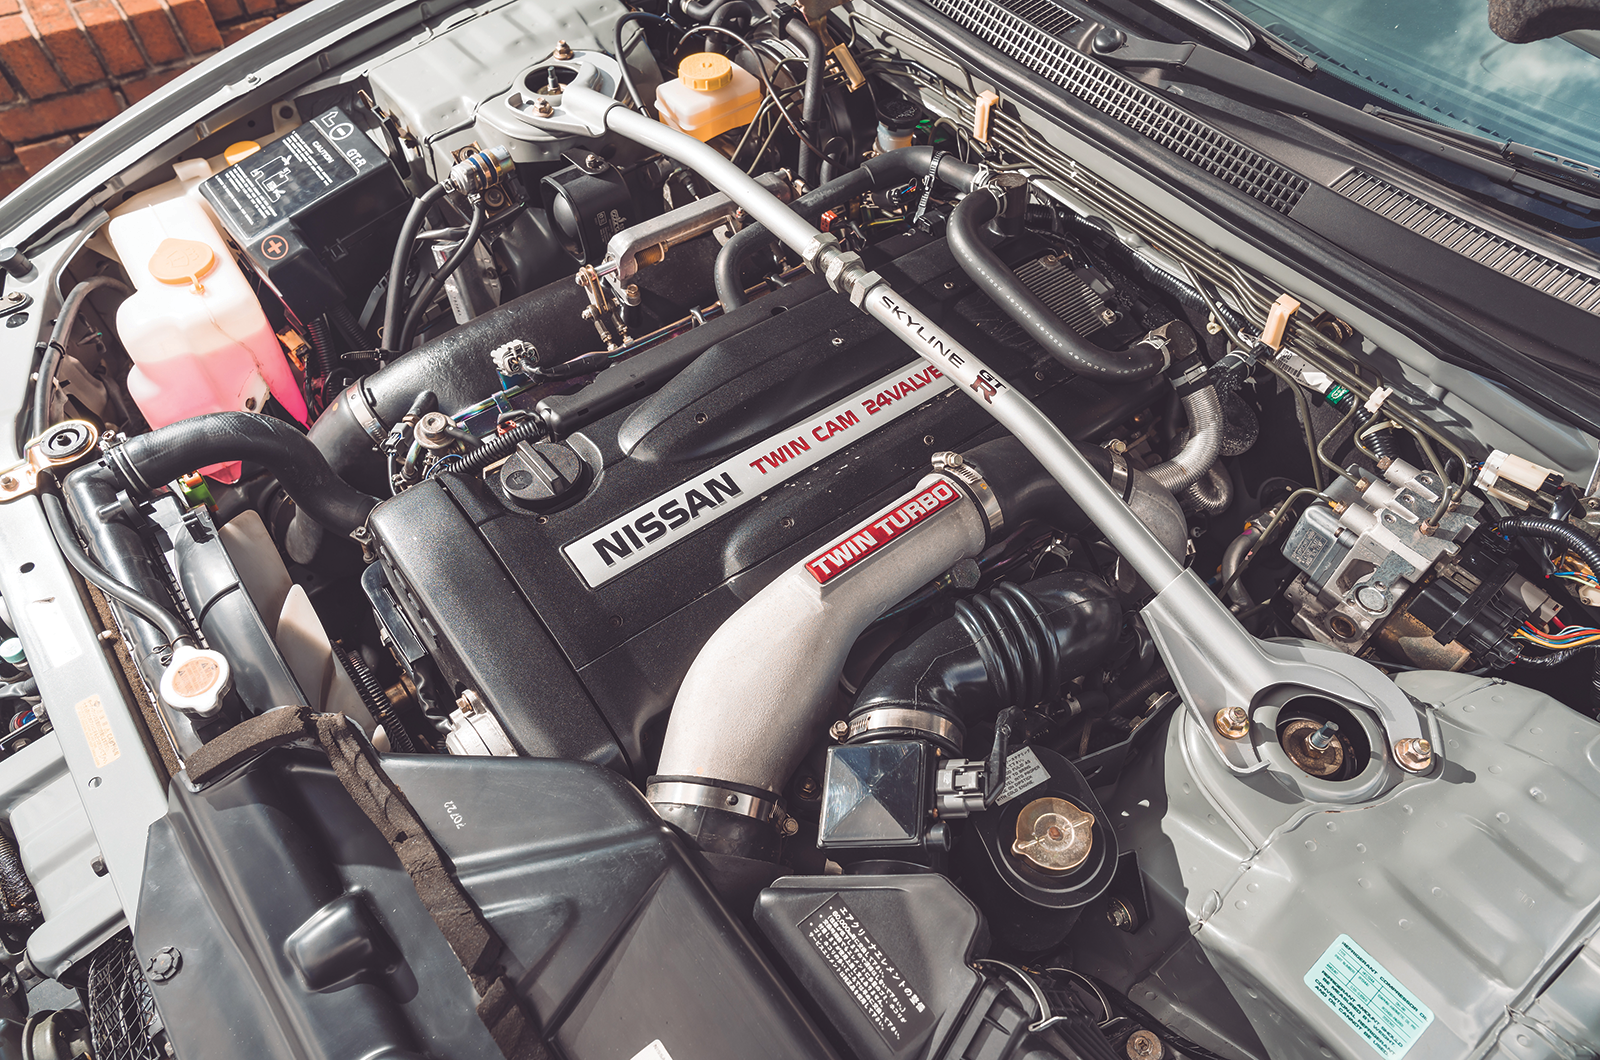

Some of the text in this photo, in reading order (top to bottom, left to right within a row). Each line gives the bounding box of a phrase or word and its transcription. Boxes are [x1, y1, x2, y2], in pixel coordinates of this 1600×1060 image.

[312, 141, 334, 163] CAUTION
[346, 148, 367, 167] GT-R
[882, 296, 965, 369] SKYLINE
[969, 374, 997, 405] R
[979, 369, 1007, 389] GT
[592, 364, 944, 567] NISSAN TWIN CAM 24VALVE
[811, 481, 953, 575] TWIN TURBO
[1321, 970, 1356, 1002] REFRIGERANT
[1357, 1004, 1380, 1025] AMOUNT
[1381, 1026, 1403, 1047] SHOULD
[1322, 977, 1330, 985] BE
[1331, 986, 1361, 1014] MEASURED
[1362, 1015, 1371, 1023] BY
[1373, 1025, 1396, 1047] WEIGHT.
[1342, 942, 1378, 974] REFRIGERANT
[1380, 976, 1418, 1012] COMPRESSOR
[1315, 986, 1327, 997] AND
[1328, 998, 1336, 1007] OIL
[1338, 1007, 1362, 1030] CANNOT
[1363, 1031, 1371, 1039] BE
[1315, 979, 1355, 1019] CONVENTIONAL
[1357, 1019, 1395, 1055] REFRIGERANT
